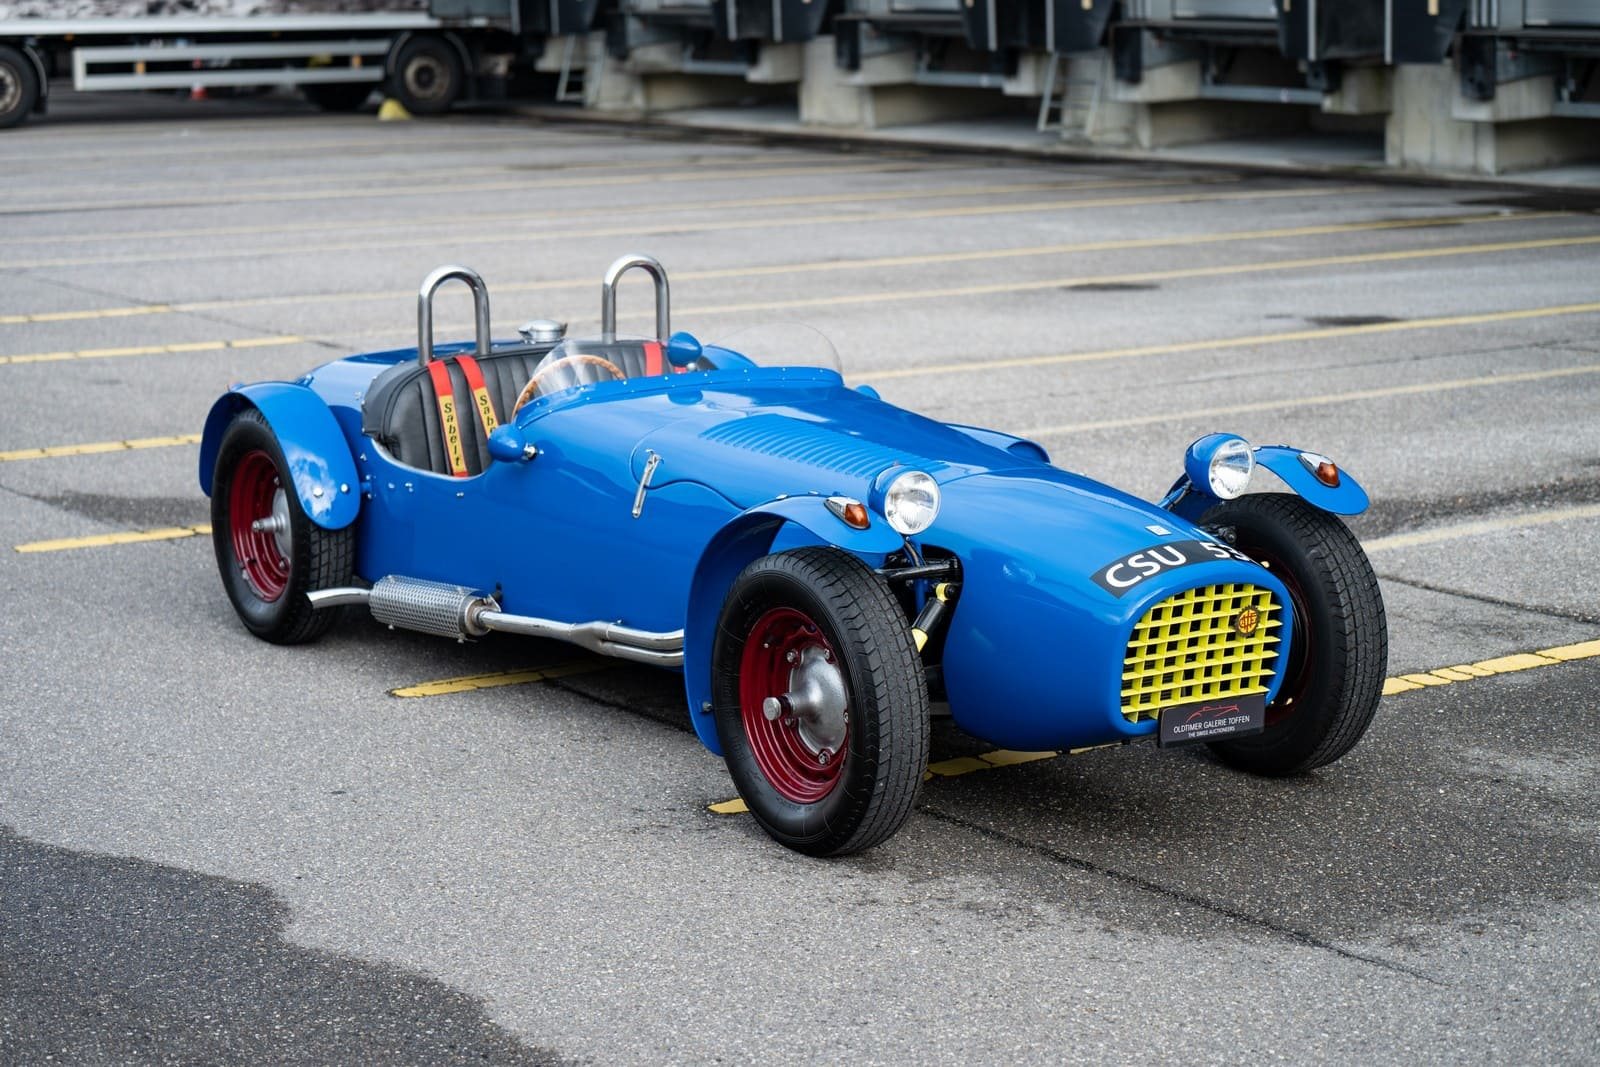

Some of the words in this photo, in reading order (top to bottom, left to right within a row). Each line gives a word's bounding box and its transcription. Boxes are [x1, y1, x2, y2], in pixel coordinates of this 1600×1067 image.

[444, 403, 460, 466] Sabelt
[1105, 546, 1187, 588] CSU
[1173, 722, 1203, 734] OLDTIMER
[1203, 719, 1227, 729] GALERIE
[1228, 715, 1250, 725] TOFFEN
